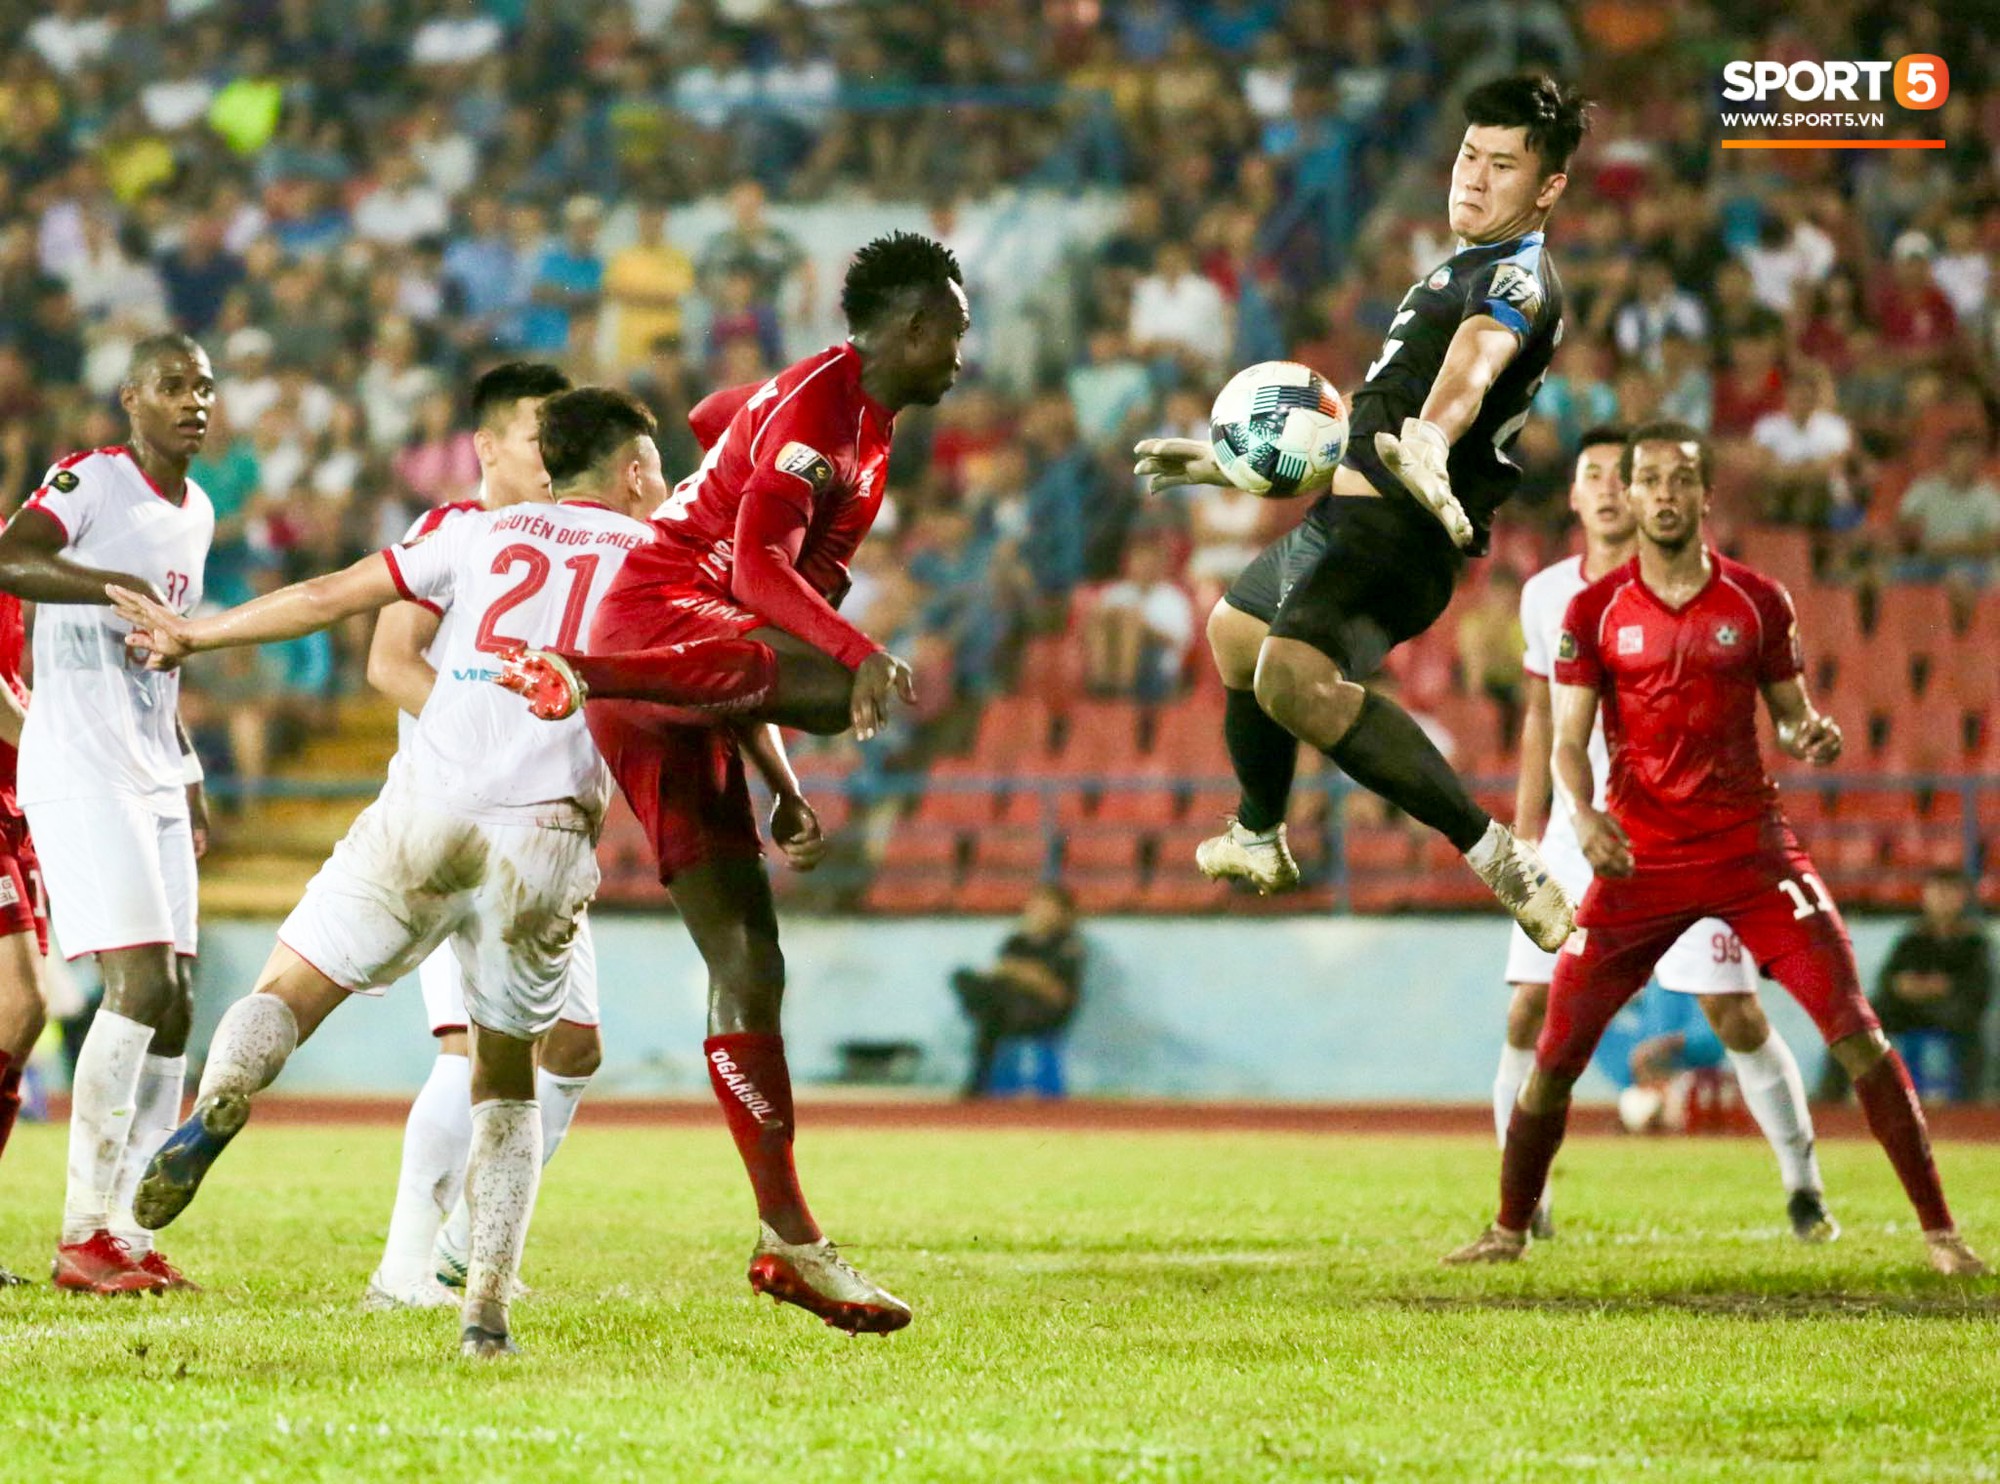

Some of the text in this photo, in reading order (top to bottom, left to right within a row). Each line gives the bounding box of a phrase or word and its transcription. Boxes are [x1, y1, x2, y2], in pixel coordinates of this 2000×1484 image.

[166, 570, 189, 606] 37
[475, 543, 600, 656] 21
[452, 669, 500, 681] VIE
[1778, 873, 1832, 920] 11
